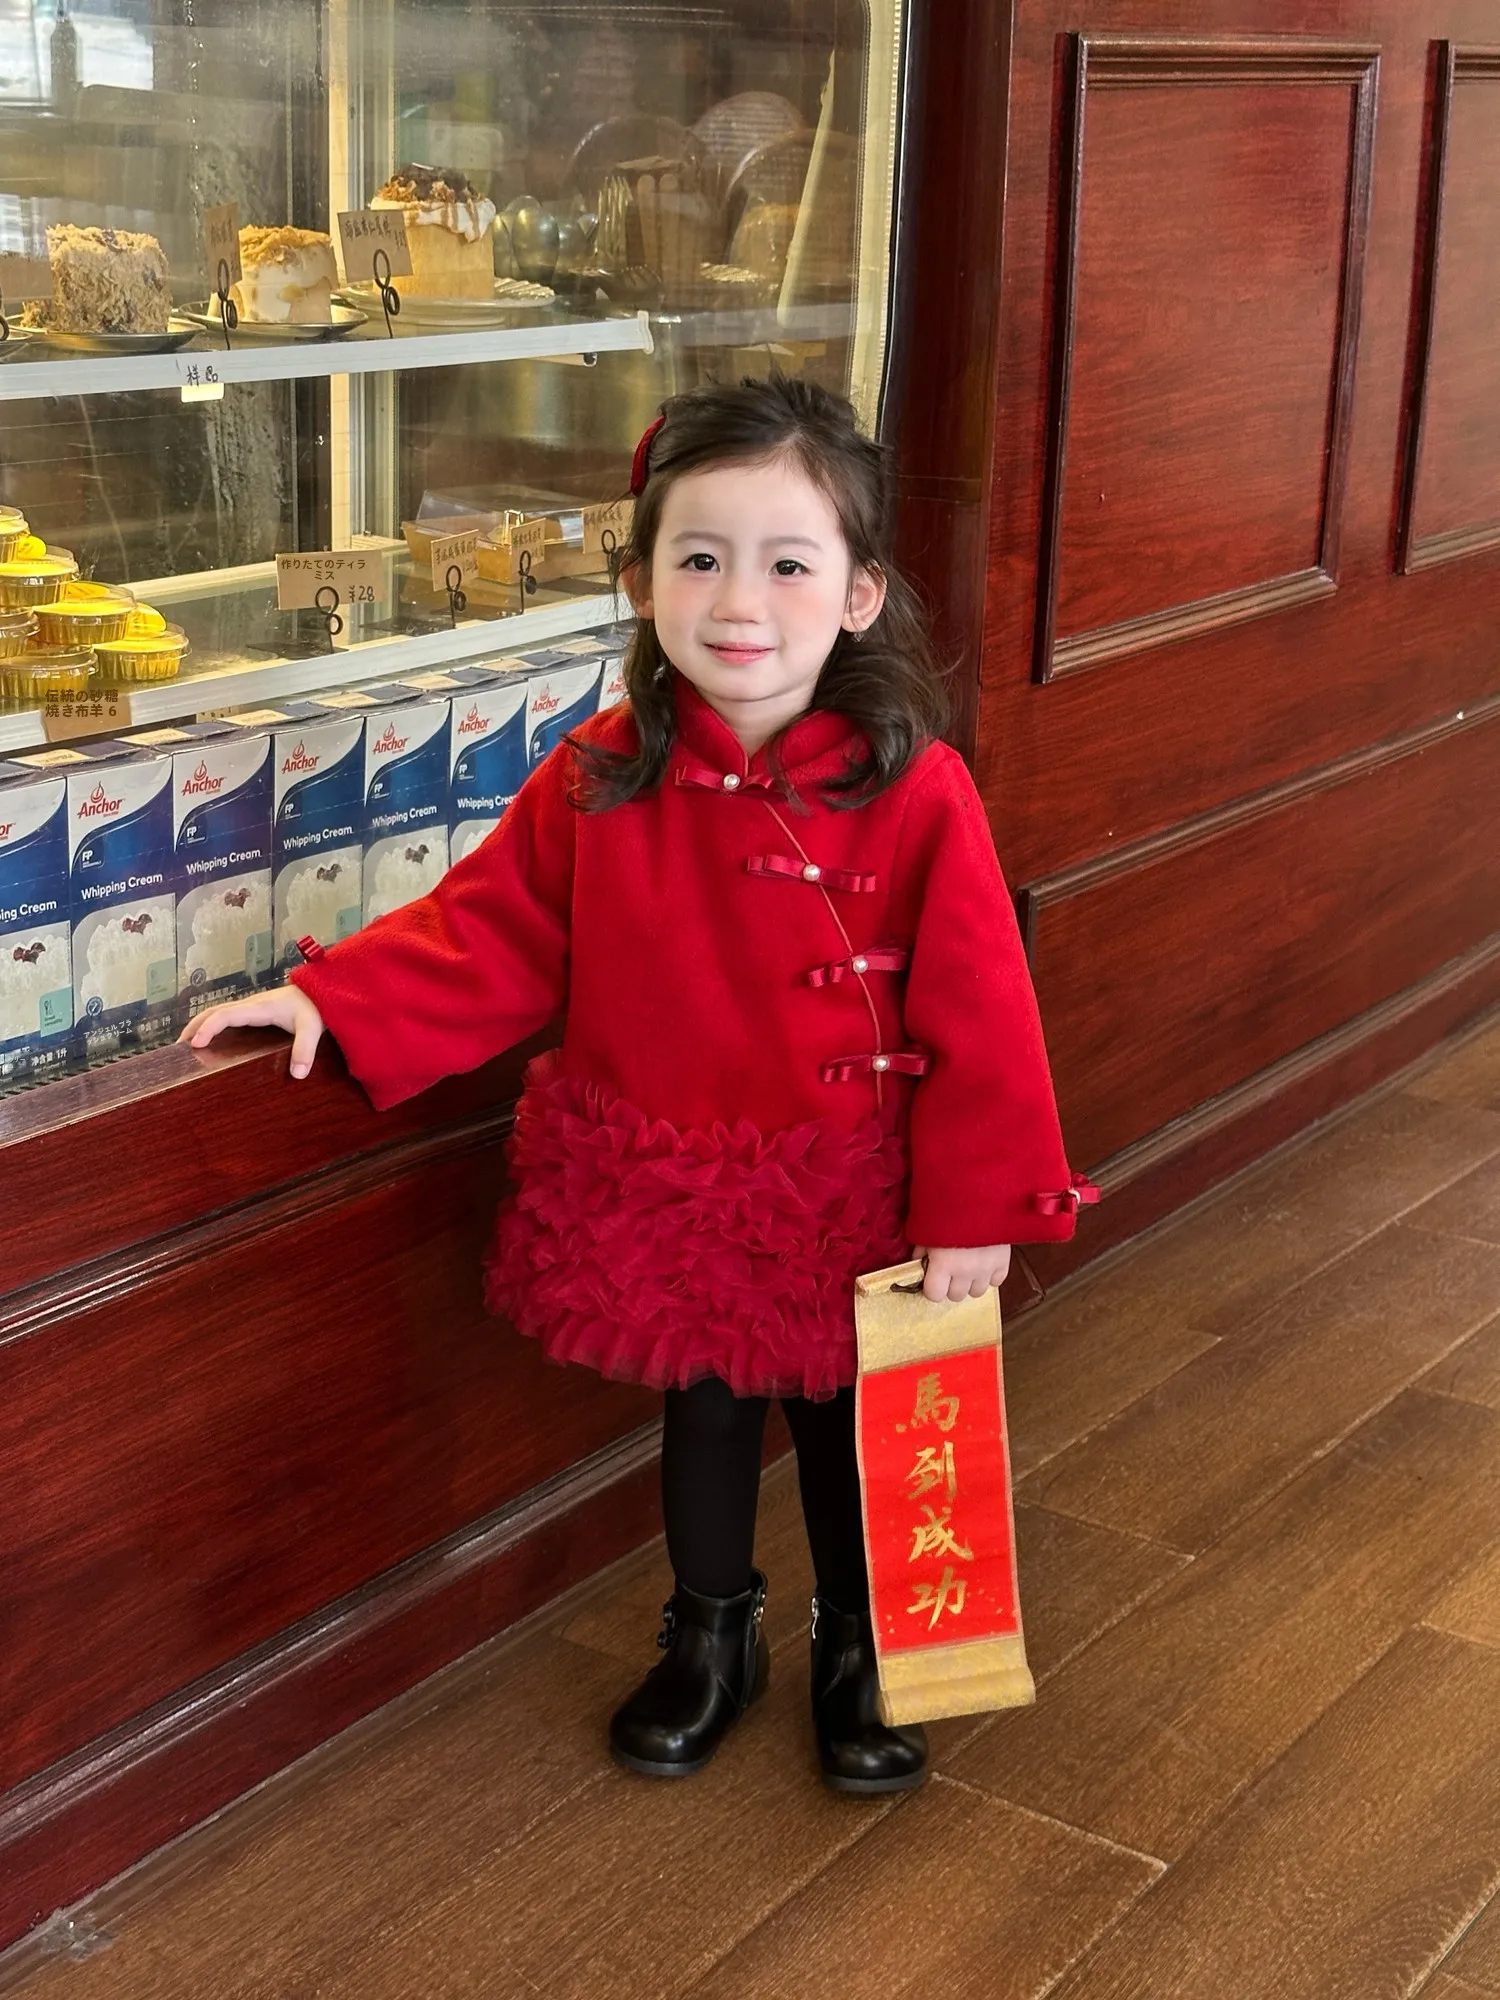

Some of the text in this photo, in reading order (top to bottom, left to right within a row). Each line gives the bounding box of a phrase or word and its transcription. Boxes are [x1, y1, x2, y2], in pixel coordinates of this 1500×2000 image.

[186, 364, 219, 387] 样品
[281, 559, 366, 570] 作りたてのティラ
[315, 570, 335, 580] ミス
[45, 689, 118, 703] 伝統の砂糖
[532, 697, 560, 713] Anchor
[45, 704, 117, 717] 焼き布羊 6
[458, 717, 490, 734] Anchor
[373, 736, 408, 755] Anchor
[281, 756, 320, 774] Anchor
[181, 776, 225, 796] Anchor
[77, 798, 123, 819] Anchor
[457, 797, 495, 810] Whipping
[372, 805, 437, 828] Whipping Cream
[283, 826, 353, 850] Whipping Cream
[186, 849, 262, 875] Whipping Cream
[81, 874, 163, 900] Whipping Cream
[20, 900, 57, 916] Cream
[896, 1372, 974, 1631] 馬到成功
